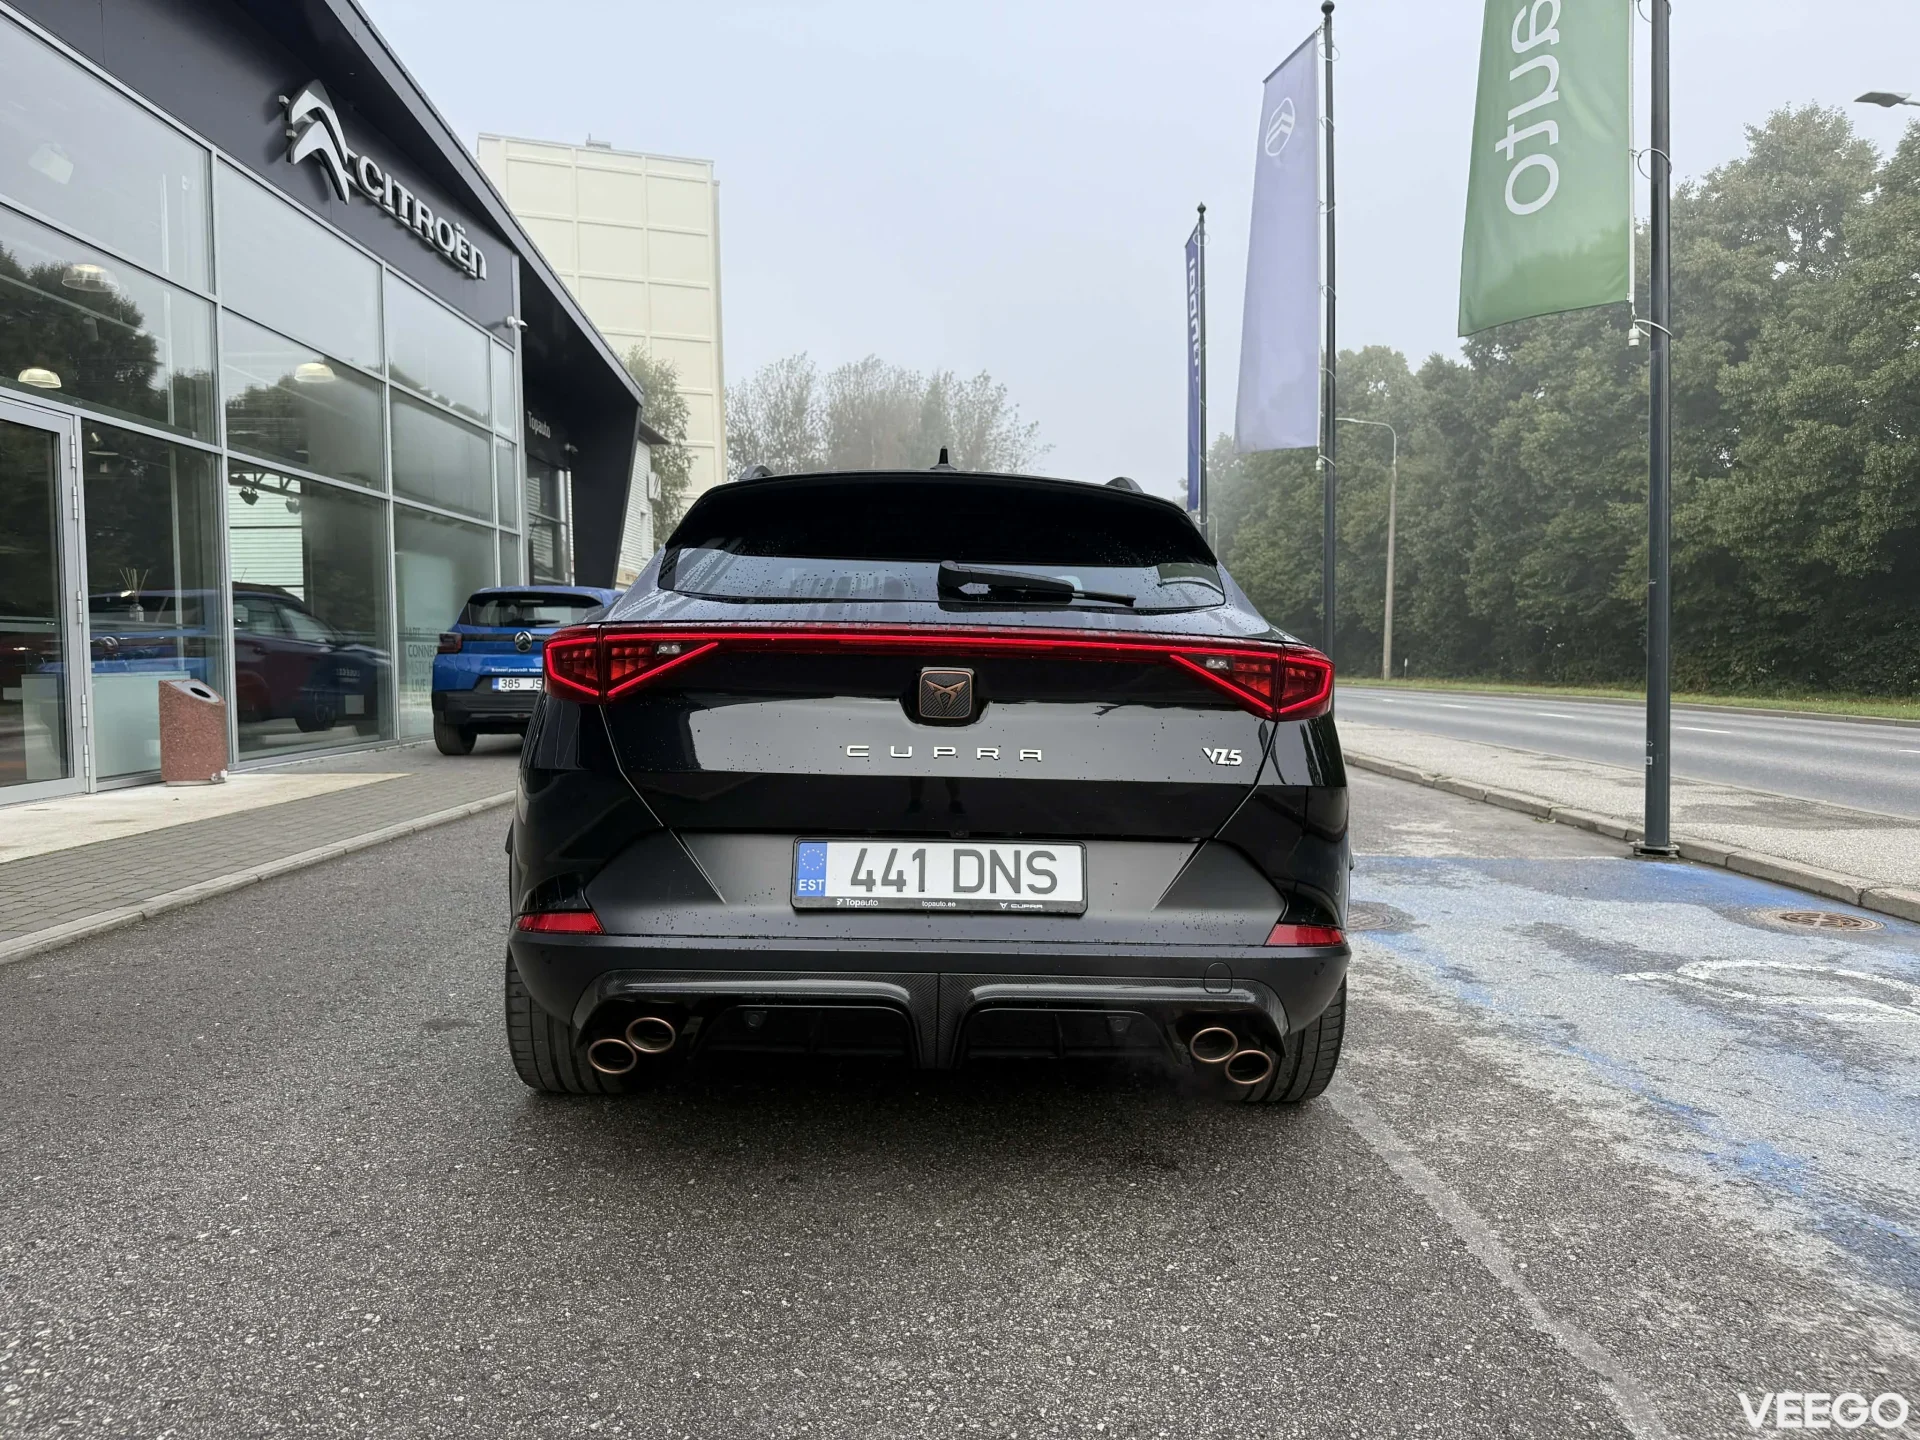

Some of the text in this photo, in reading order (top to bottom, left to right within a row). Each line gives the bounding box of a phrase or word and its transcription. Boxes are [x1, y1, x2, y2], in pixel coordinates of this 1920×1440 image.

[527, 410, 551, 439] Topauto
[408, 644, 439, 658] CONNEC
[501, 678, 521, 689] 385
[529, 678, 543, 689] JS
[846, 744, 1043, 761] CUPRA
[850, 847, 1058, 895] 441 DNS
[798, 878, 825, 891] EST
[845, 898, 879, 908] Topauto
[922, 900, 957, 908] topauto.ee
